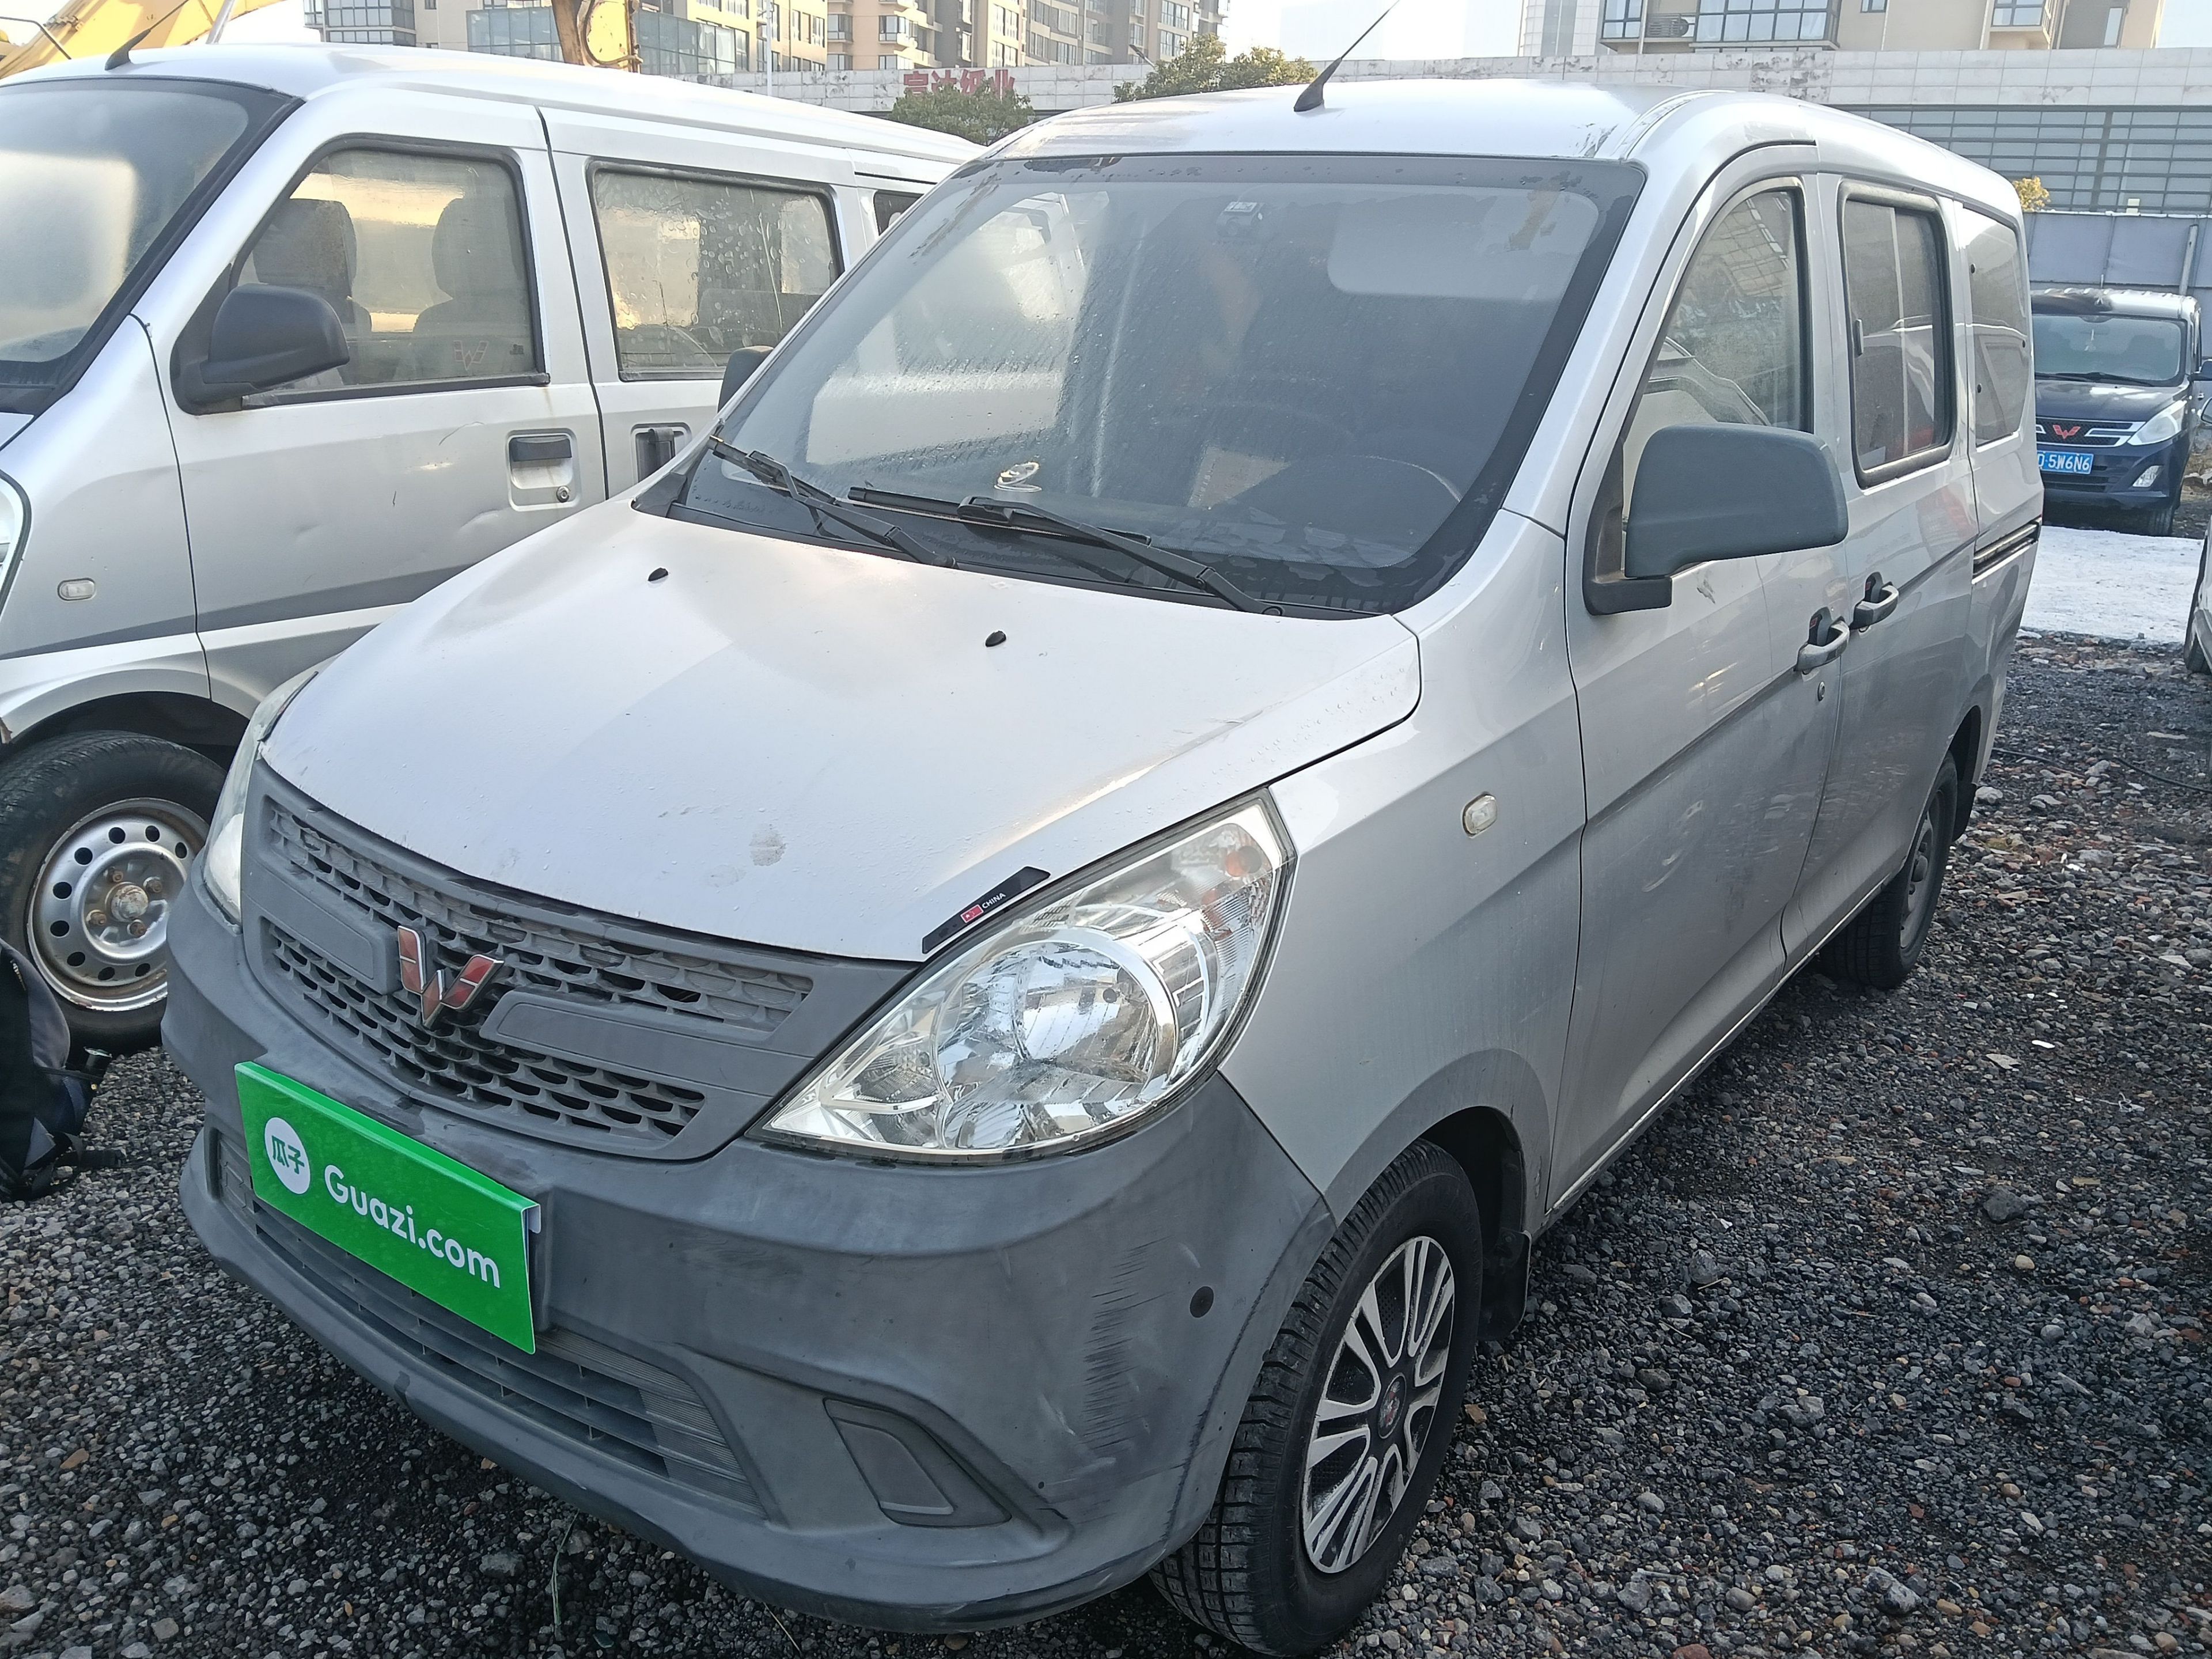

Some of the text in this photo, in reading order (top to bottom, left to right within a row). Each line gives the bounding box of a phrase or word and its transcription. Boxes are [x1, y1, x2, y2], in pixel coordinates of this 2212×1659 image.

[982, 892, 1006, 909] CHINA
[271, 1135, 305, 1175] 瓜子
[324, 1164, 501, 1289] Guazi.com
